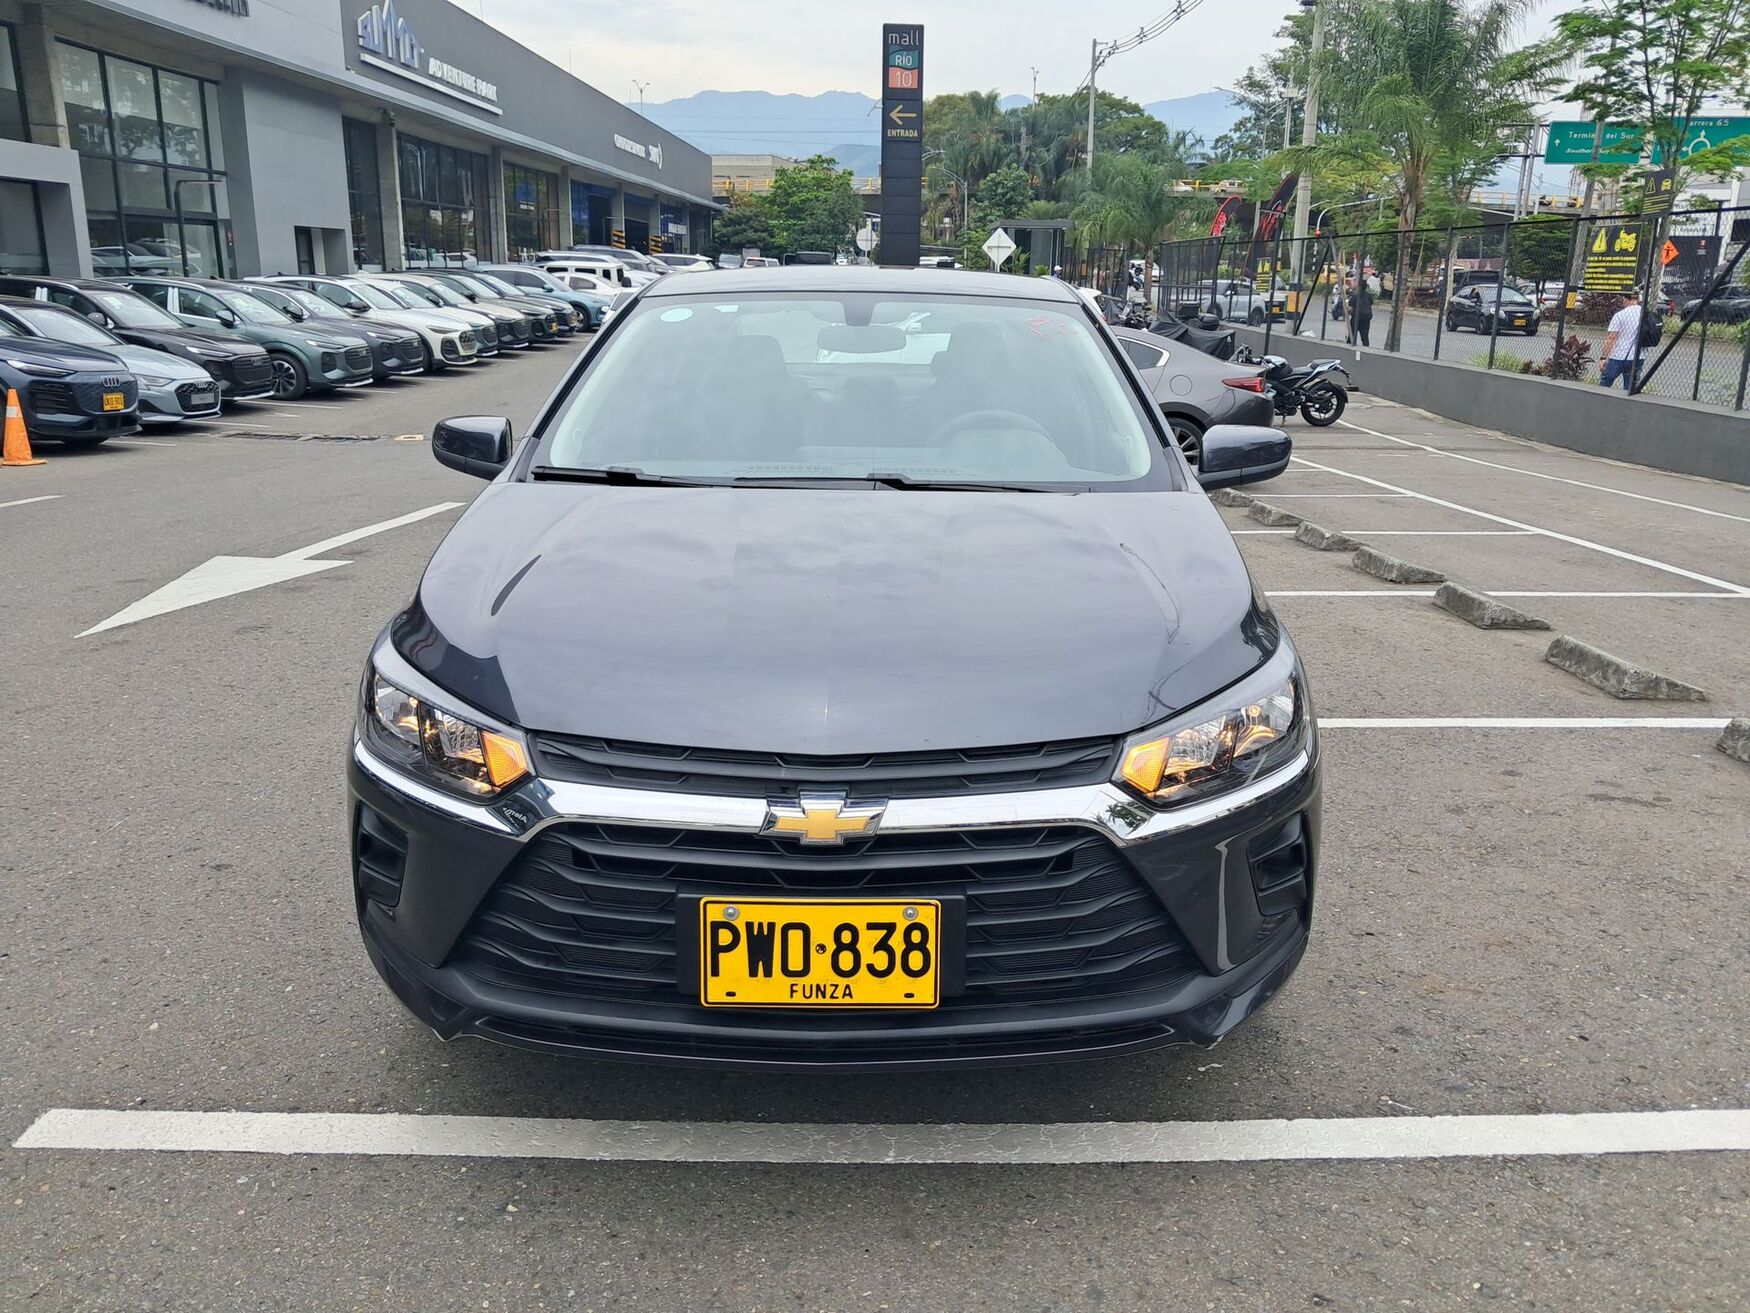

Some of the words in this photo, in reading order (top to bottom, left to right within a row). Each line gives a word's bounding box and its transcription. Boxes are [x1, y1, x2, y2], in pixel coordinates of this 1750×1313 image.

[888, 30, 919, 45] mall
[895, 52, 912, 66] RÍO
[895, 71, 912, 88] 10
[1716, 119, 1729, 127] 65
[887, 129, 918, 137] ENTRADA
[1605, 131, 1618, 139] del
[1620, 131, 1635, 139] Sur
[790, 983, 854, 999] FUNZA
